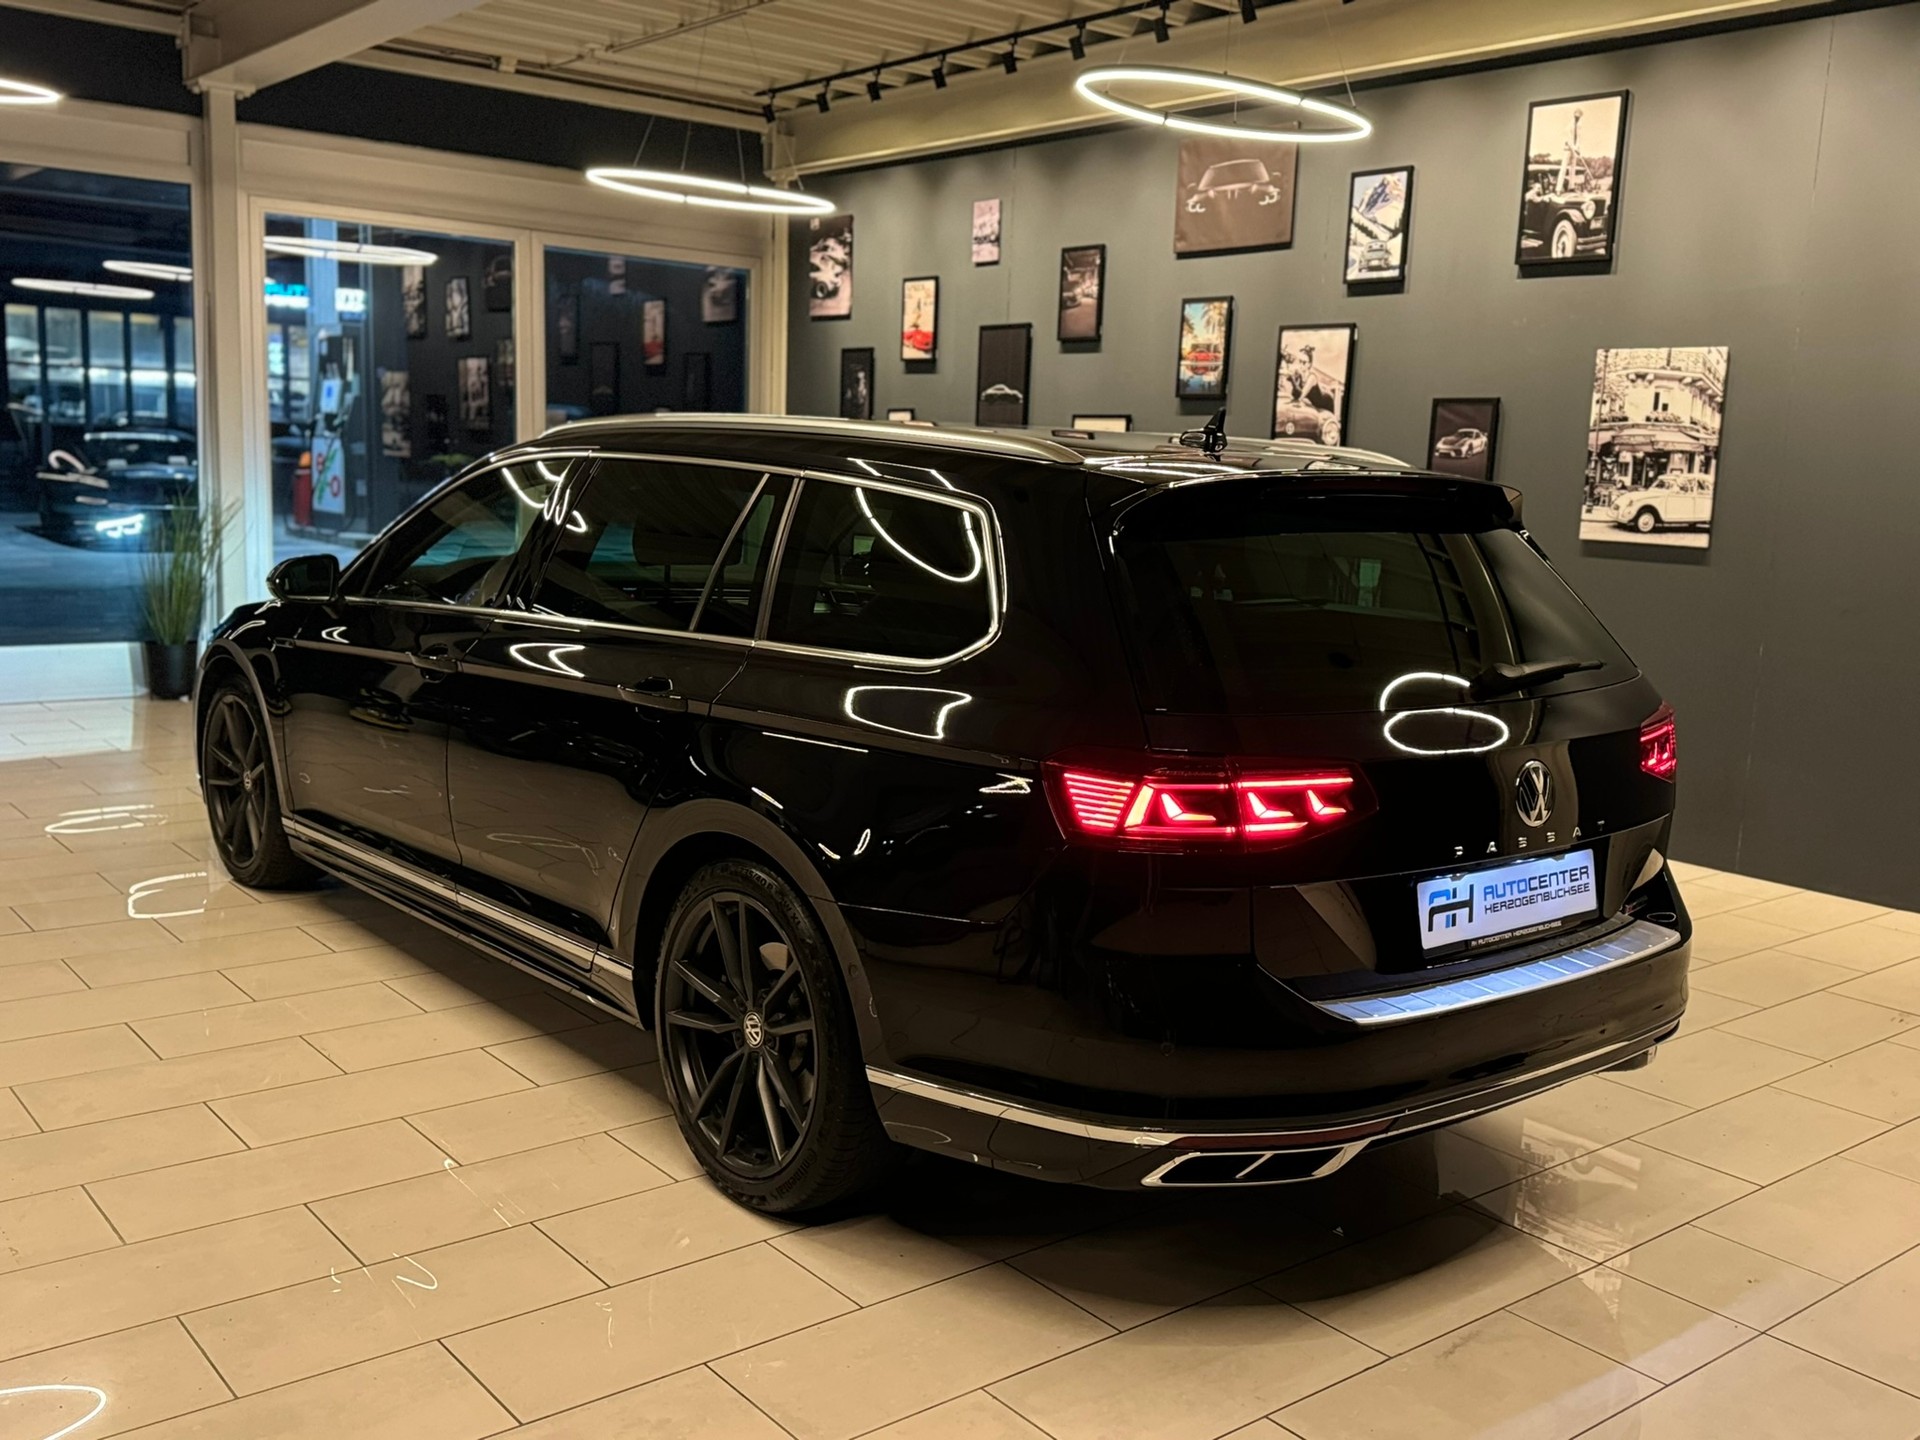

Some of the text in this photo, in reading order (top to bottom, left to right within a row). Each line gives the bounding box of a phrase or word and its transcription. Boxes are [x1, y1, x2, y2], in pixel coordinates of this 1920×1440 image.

[1453, 820, 1605, 858] PASSAT
[1483, 865, 1590, 902] AUTOCENTER
[1484, 882, 1591, 915] HERZOGENBUCHSEE
